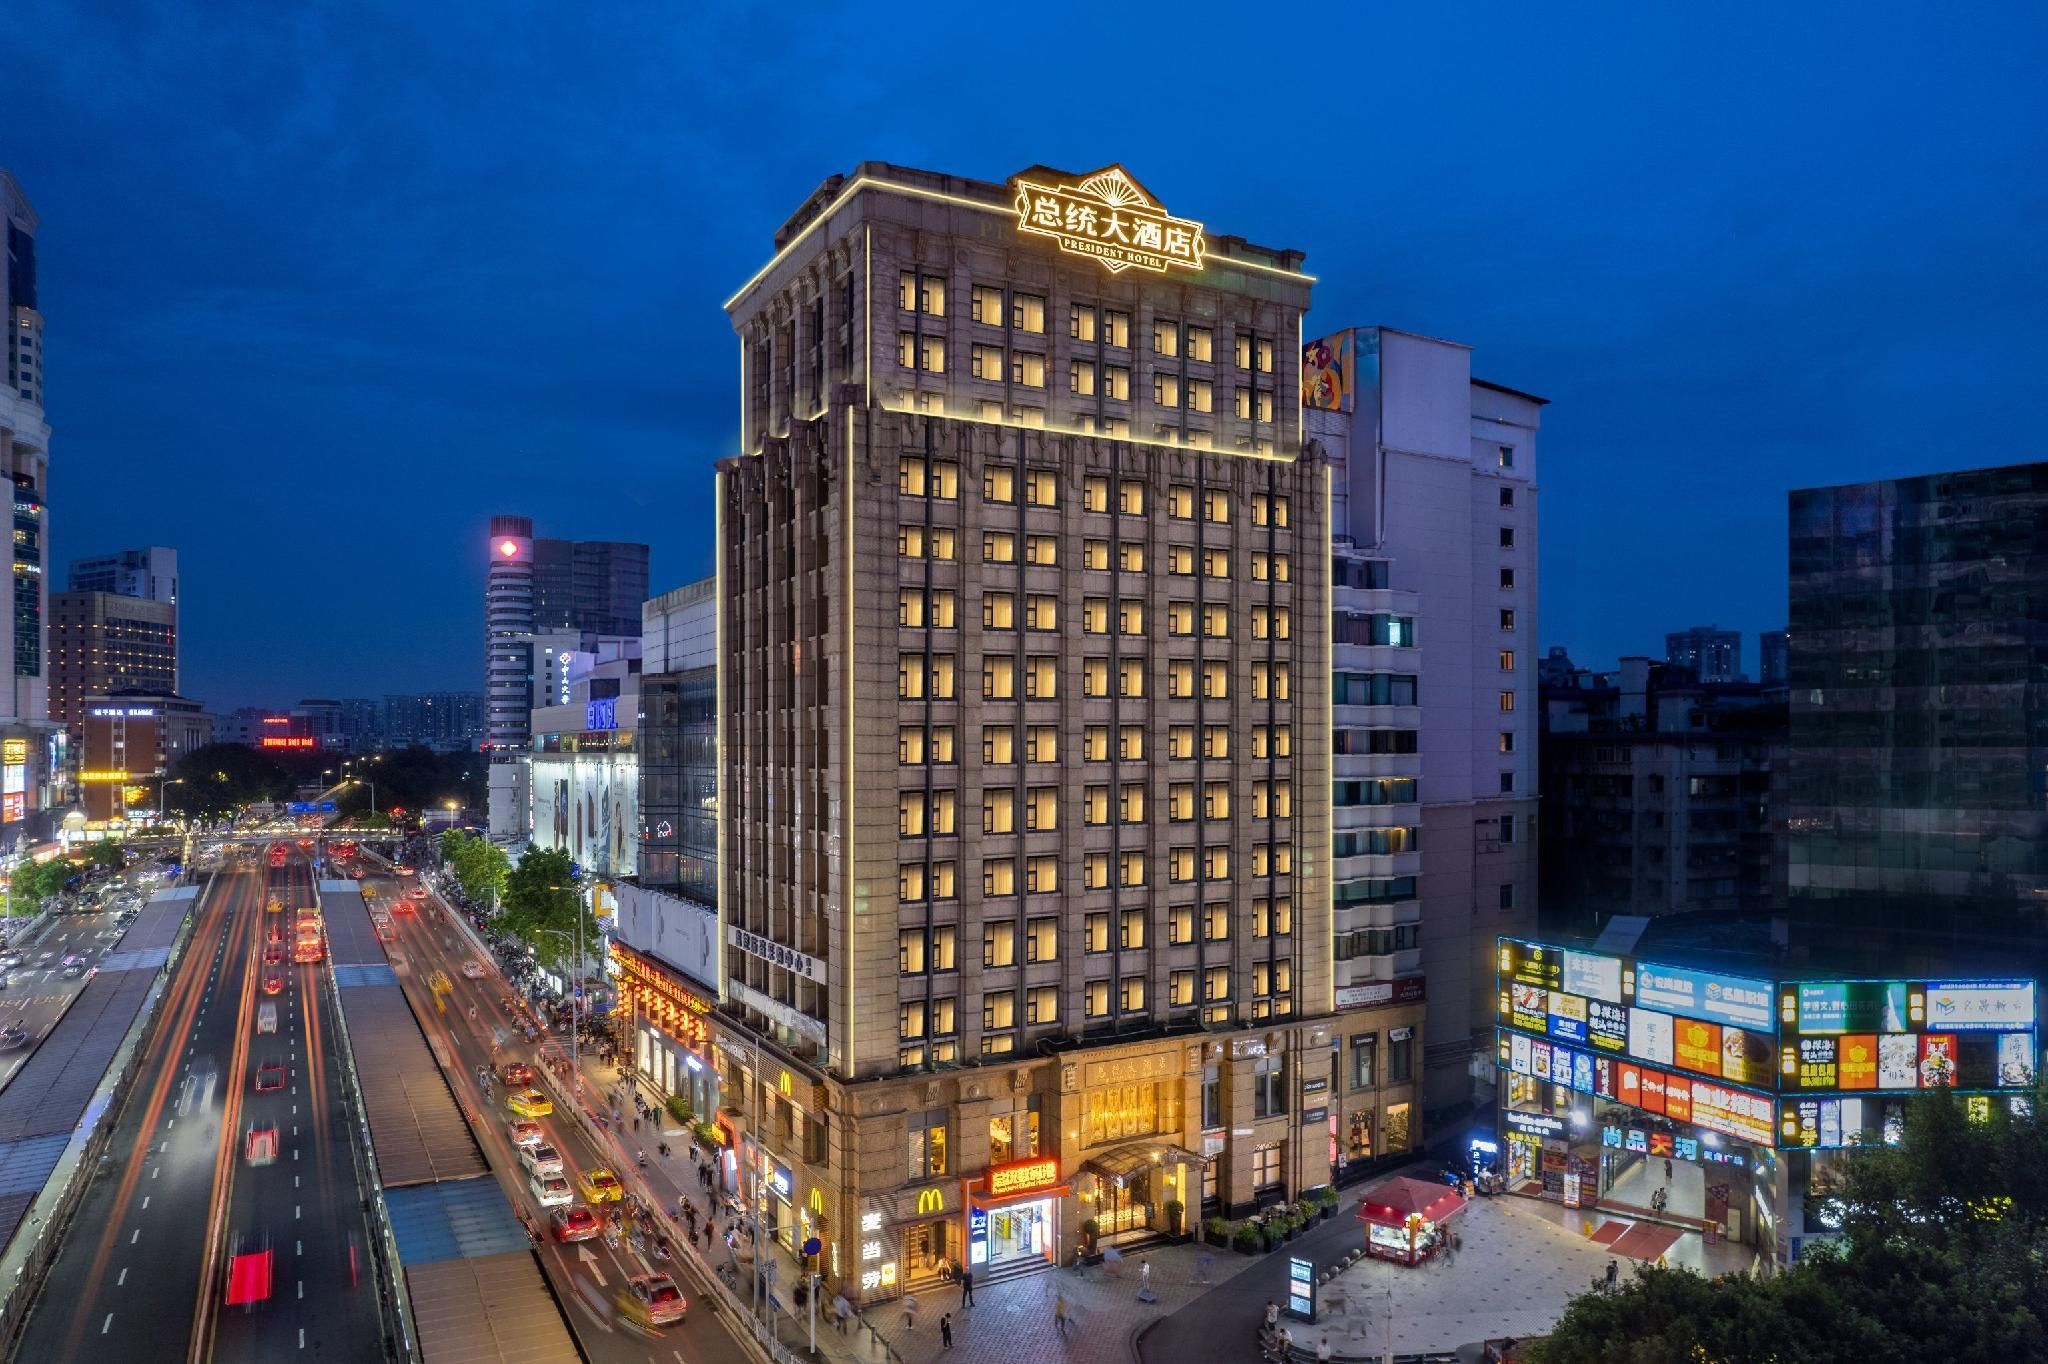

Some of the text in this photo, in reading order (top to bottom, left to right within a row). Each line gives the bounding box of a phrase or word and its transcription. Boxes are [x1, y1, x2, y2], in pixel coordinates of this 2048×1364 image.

[1031, 195, 1192, 257] 总统大酒店
[1063, 237, 1162, 268] PRESIDENT HOTEL
[1602, 1125, 1697, 1161] 尚品天河
[861, 1212, 882, 1290] 麦当劳
